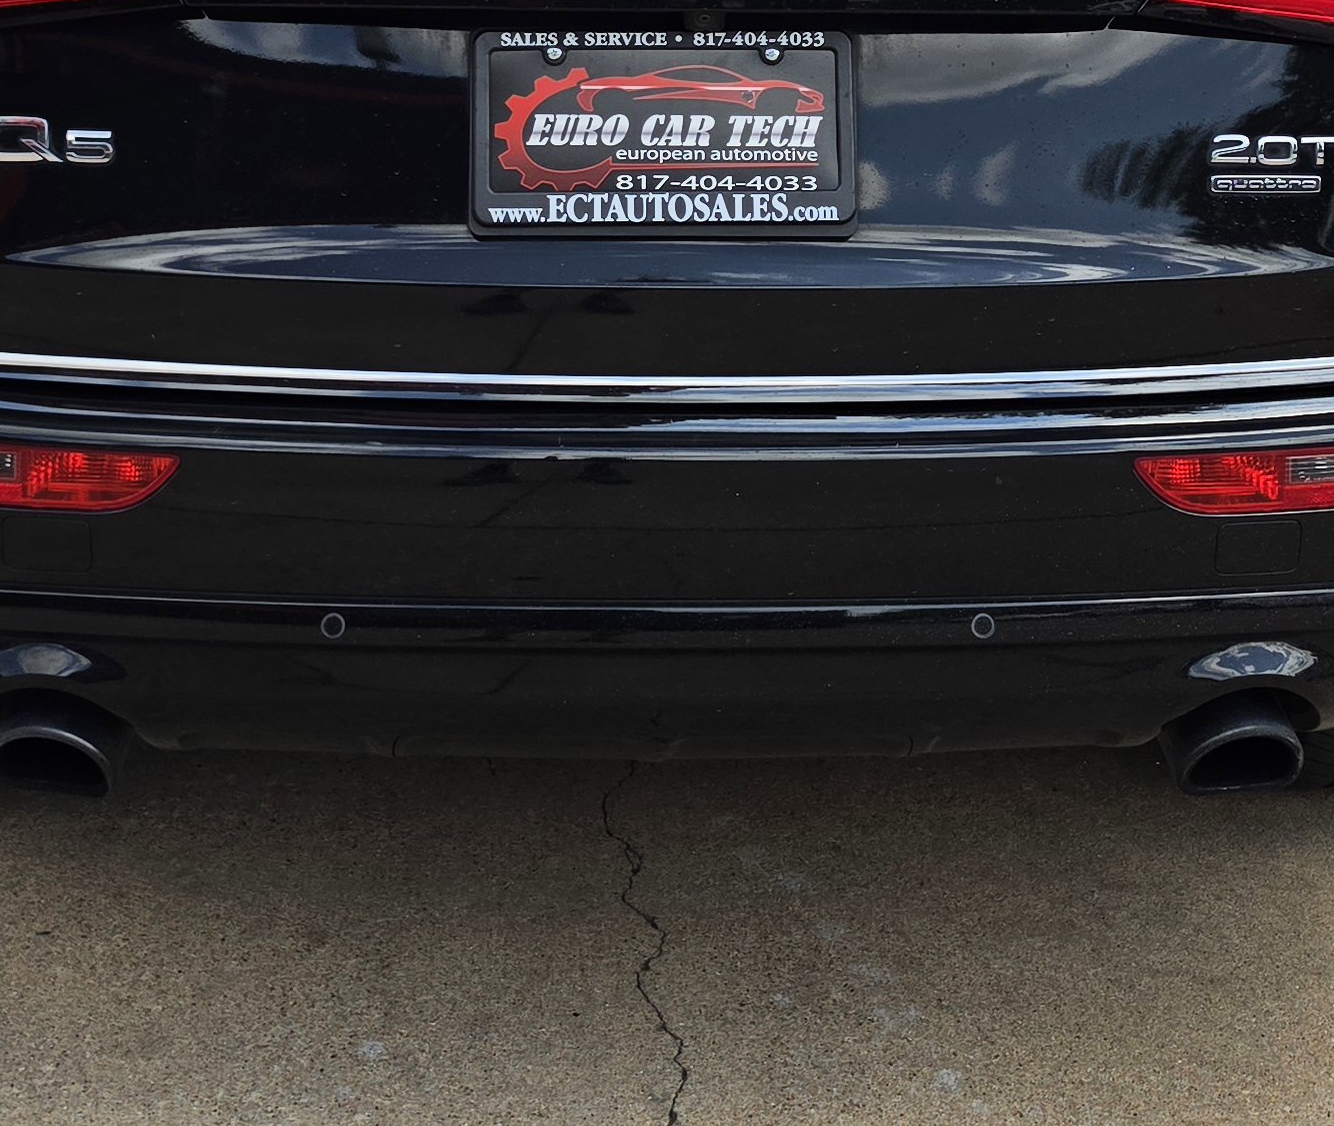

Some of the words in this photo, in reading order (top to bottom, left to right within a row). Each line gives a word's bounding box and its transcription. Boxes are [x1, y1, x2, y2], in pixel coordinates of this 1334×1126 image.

[500, 32, 558, 47] SALES
[563, 32, 579, 47] &
[584, 32, 668, 47] SERVICE
[692, 31, 825, 47] 817-404-4033
[525, 113, 630, 146] EURO
[640, 113, 716, 147] CAR
[726, 115, 825, 148] TECH
[615, 148, 706, 163] european
[710, 147, 819, 162] automotive
[616, 174, 818, 191] 817-404-4033
[1216, 177, 1317, 191] quattro
[488, 192, 840, 223] www.ECTAUTOSALES.com
